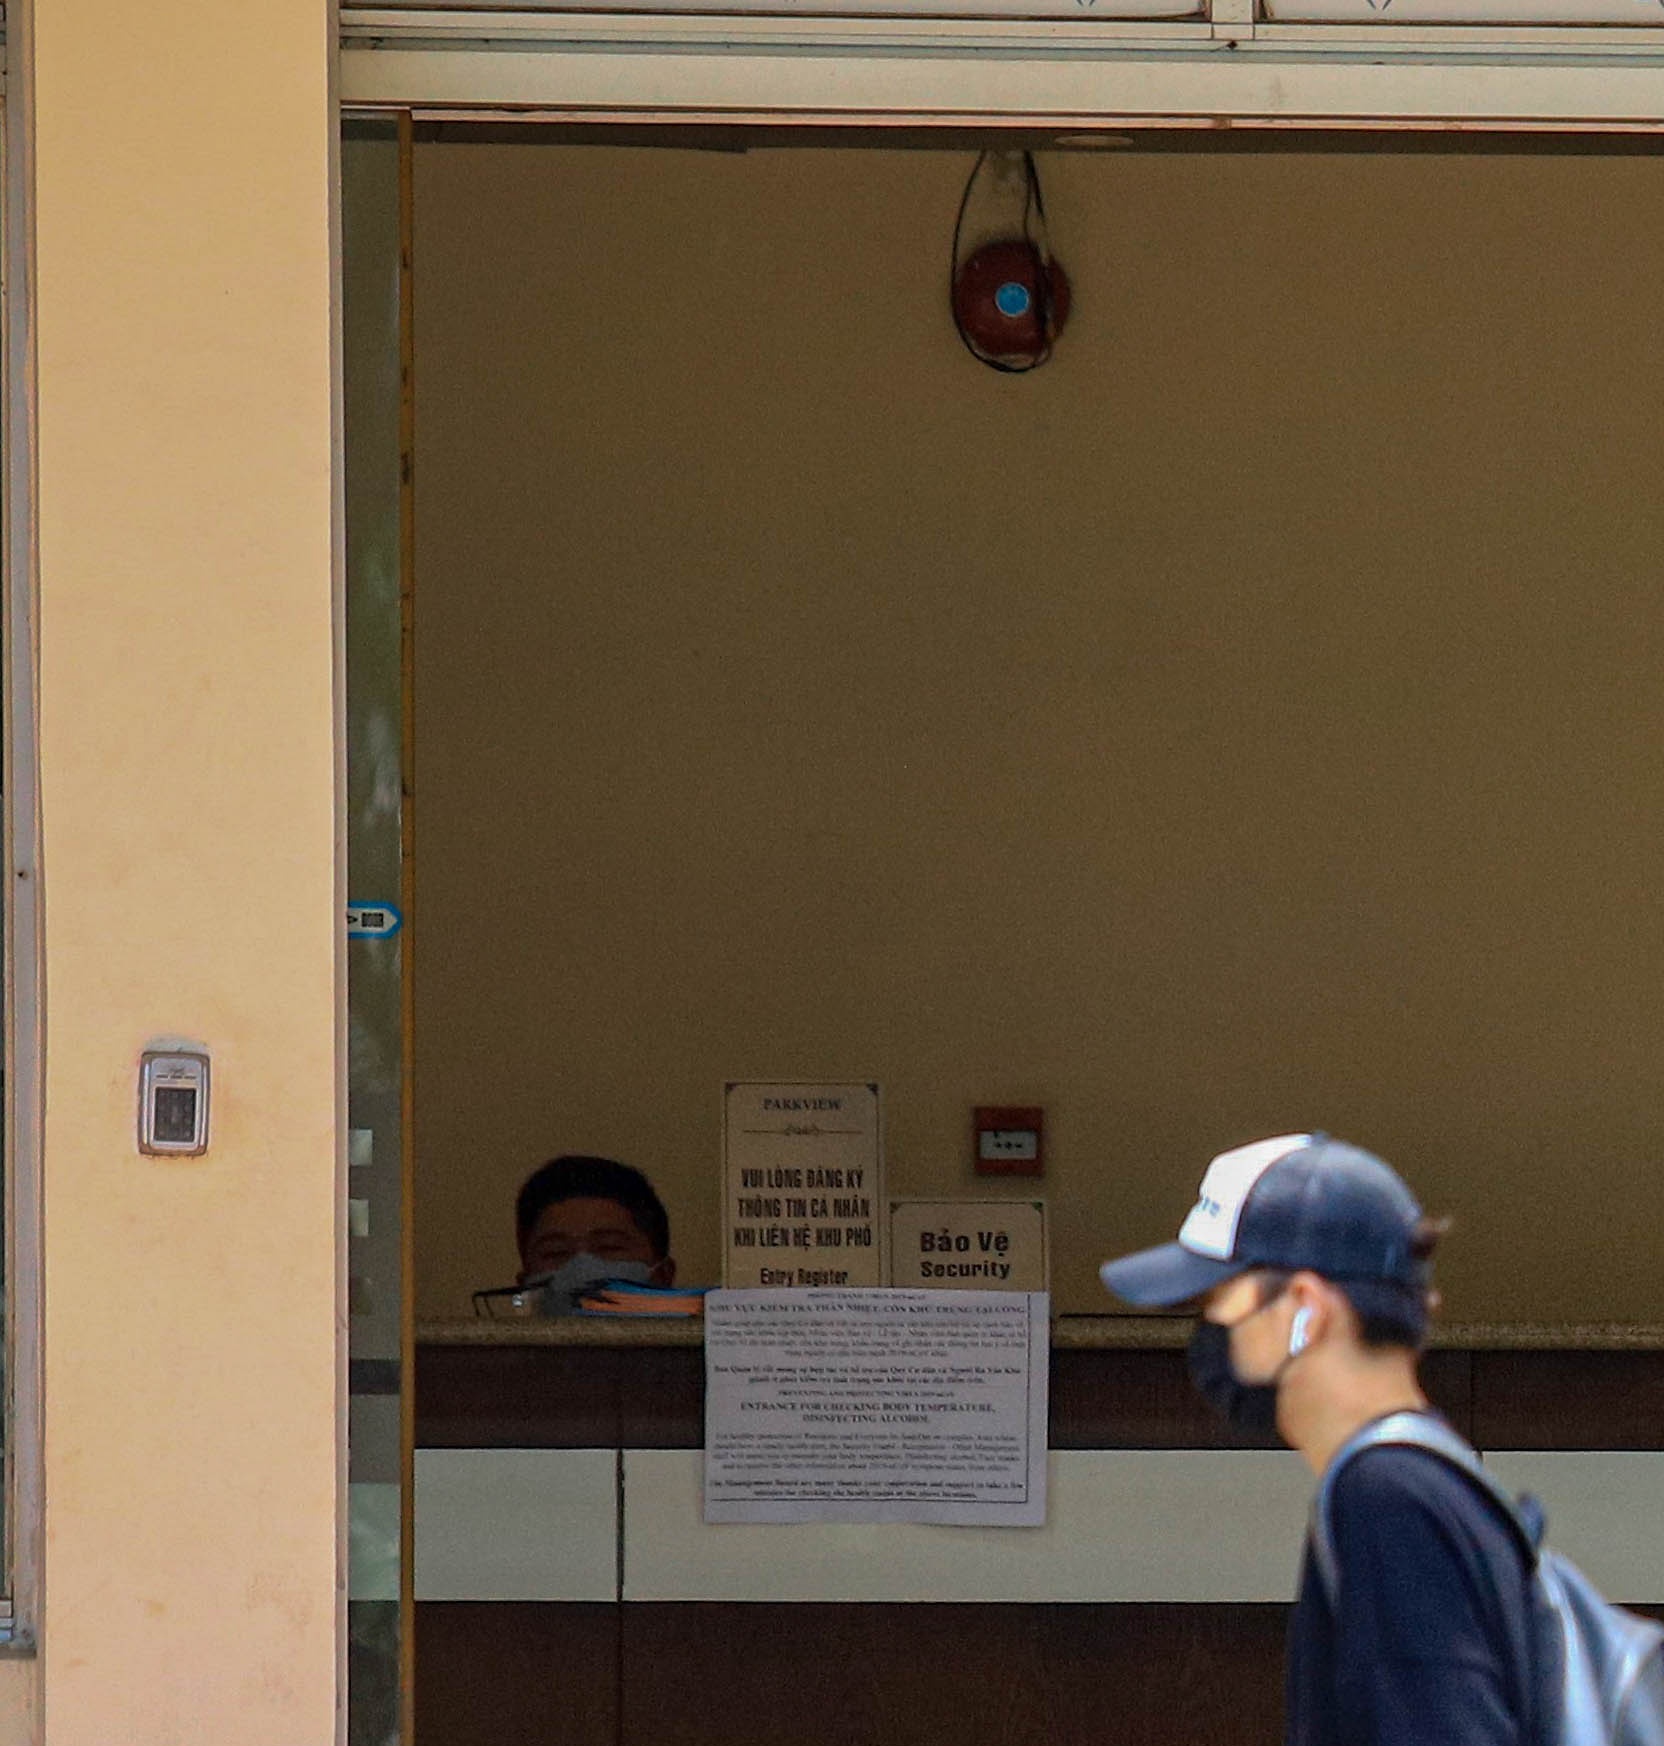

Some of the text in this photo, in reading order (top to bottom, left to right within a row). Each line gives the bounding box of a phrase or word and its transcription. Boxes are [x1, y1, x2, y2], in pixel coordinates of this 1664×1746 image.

[921, 1227, 1009, 1257] Bảo Vệ
[920, 1260, 1010, 1280] Security
